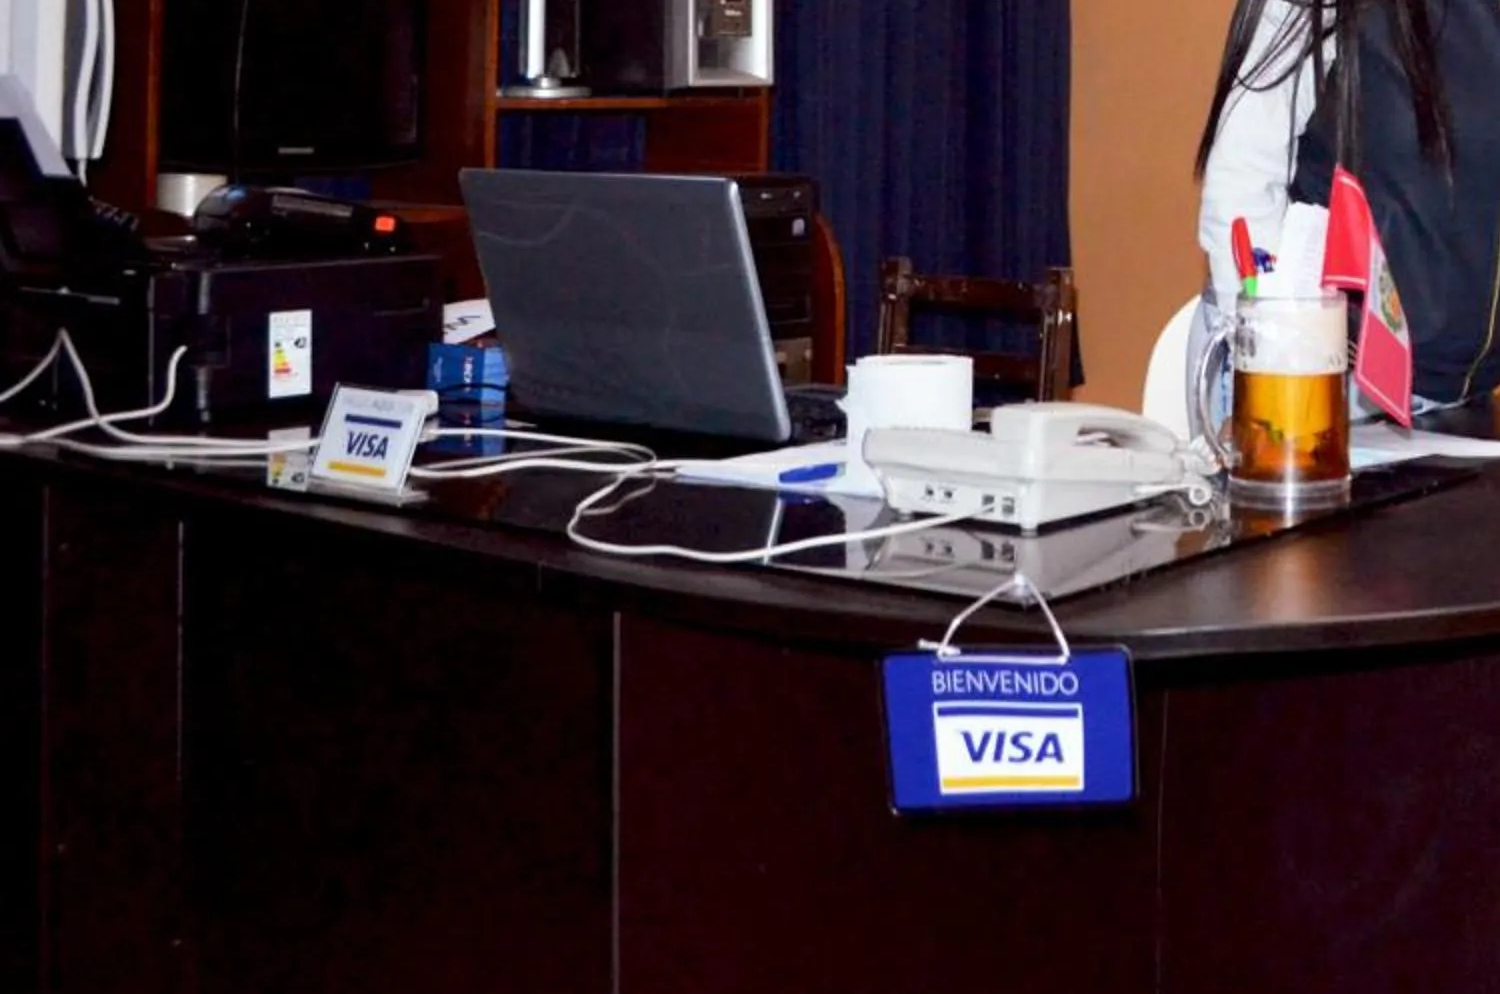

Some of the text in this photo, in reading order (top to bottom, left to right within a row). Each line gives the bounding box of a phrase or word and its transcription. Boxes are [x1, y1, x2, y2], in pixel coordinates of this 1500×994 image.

[346, 430, 389, 460] VISA
[932, 670, 1079, 695] BIENVENIDO
[961, 731, 1064, 764] VISA
